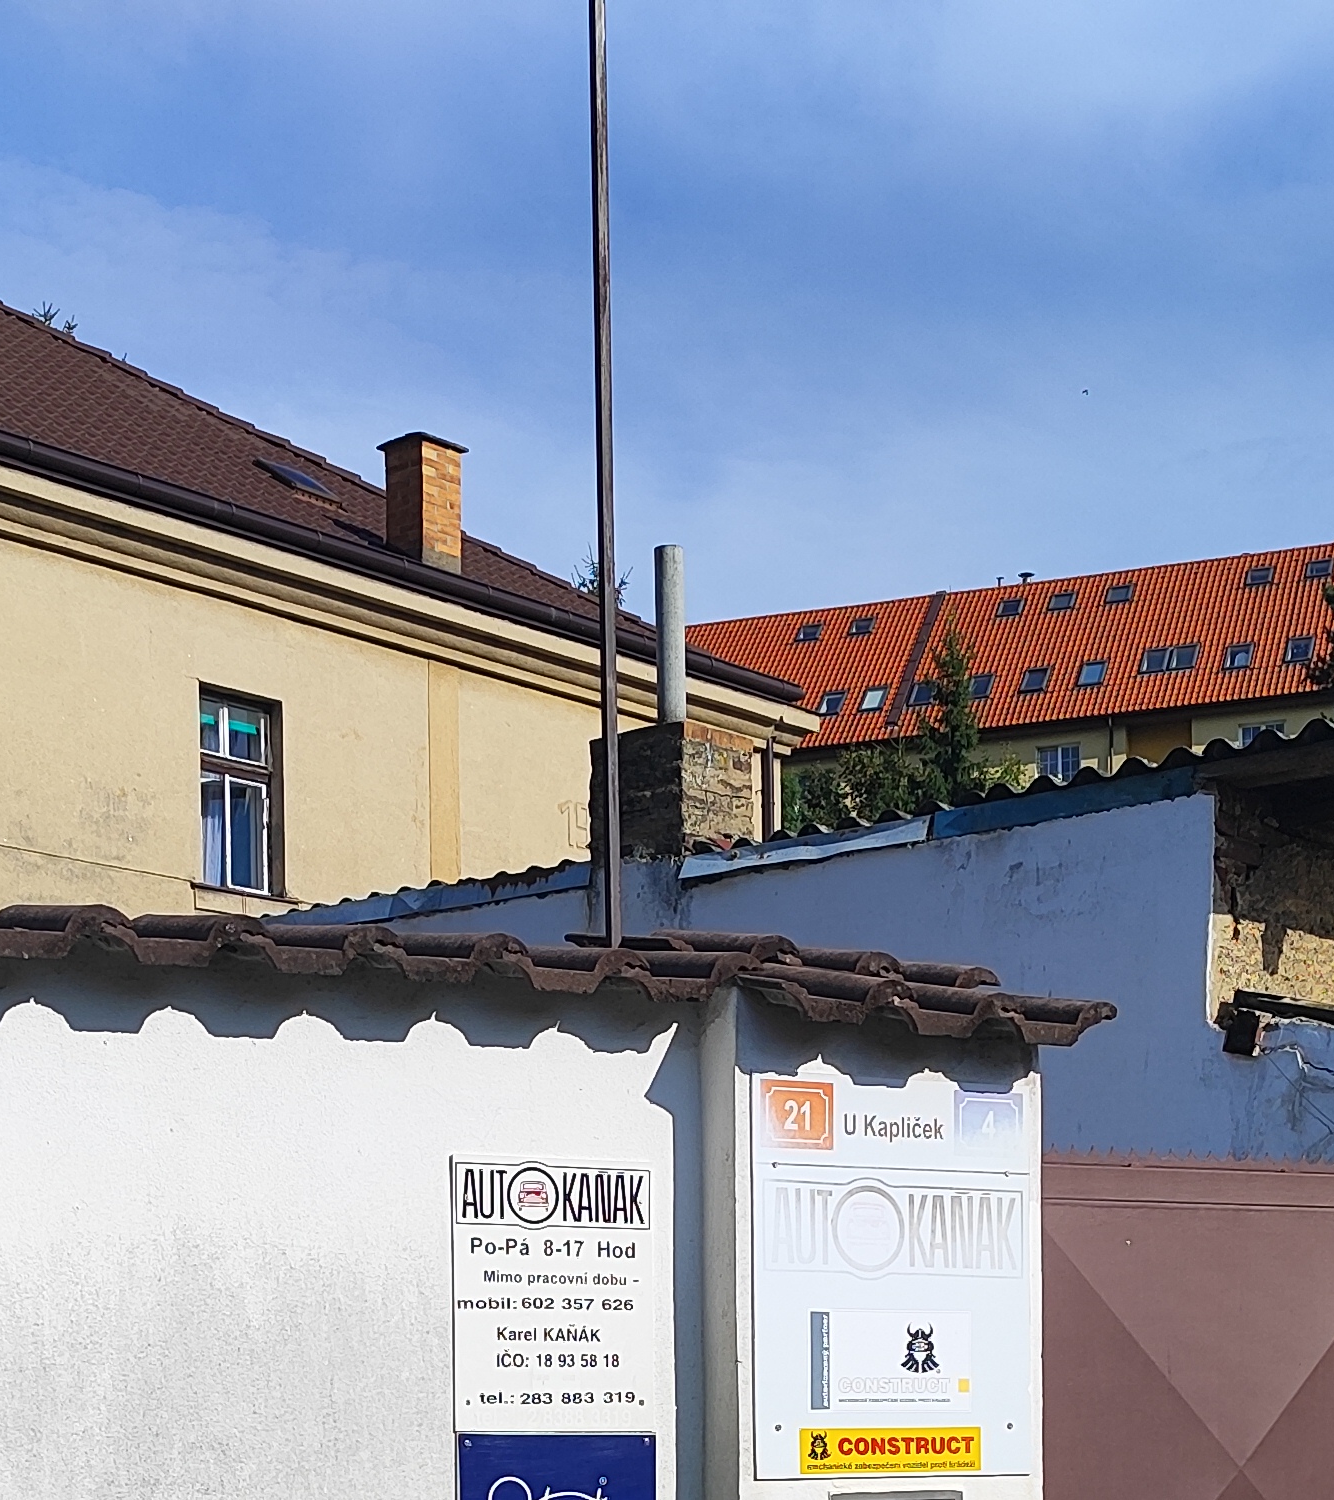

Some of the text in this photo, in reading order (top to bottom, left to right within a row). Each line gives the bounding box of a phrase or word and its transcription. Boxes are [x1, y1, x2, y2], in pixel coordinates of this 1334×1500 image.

[783, 1099, 812, 1131] 21
[981, 1110, 996, 1135] 4
[843, 1113, 944, 1143] U Kapliček
[470, 1237, 636, 1259] Po-Pá 8-17 Hod
[483, 1270, 523, 1284] Mimo
[527, 1272, 588, 1287] pracovní
[592, 1273, 627, 1286] dobu
[457, 1296, 634, 1312] mobil: 602 357 626
[496, 1323, 601, 1343] Karel KAŇÁK
[496, 1348, 620, 1368] IČO: 18 93 58 18
[838, 1377, 951, 1393] CONSTRUCT
[479, 1391, 636, 1405] tel.: 283 883 319
[837, 1436, 975, 1456] CONSTRUCT
